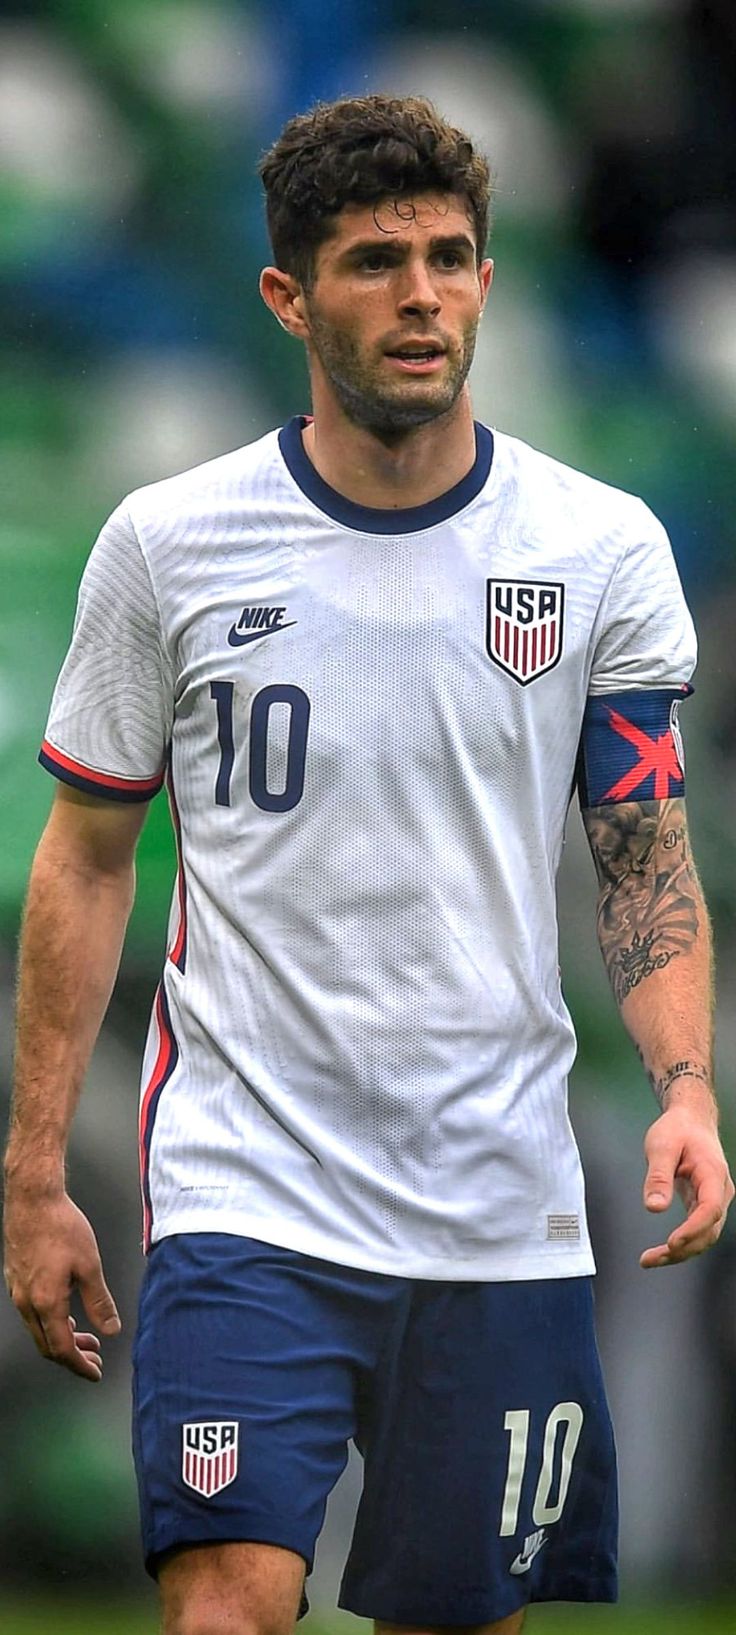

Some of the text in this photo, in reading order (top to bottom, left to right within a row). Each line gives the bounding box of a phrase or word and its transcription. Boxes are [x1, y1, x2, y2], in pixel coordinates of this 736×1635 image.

[237, 607, 286, 629] NIKE
[495, 587, 556, 624] USA
[210, 681, 310, 812] 10
[187, 1426, 236, 1454] USA
[500, 1402, 583, 1536] 10
